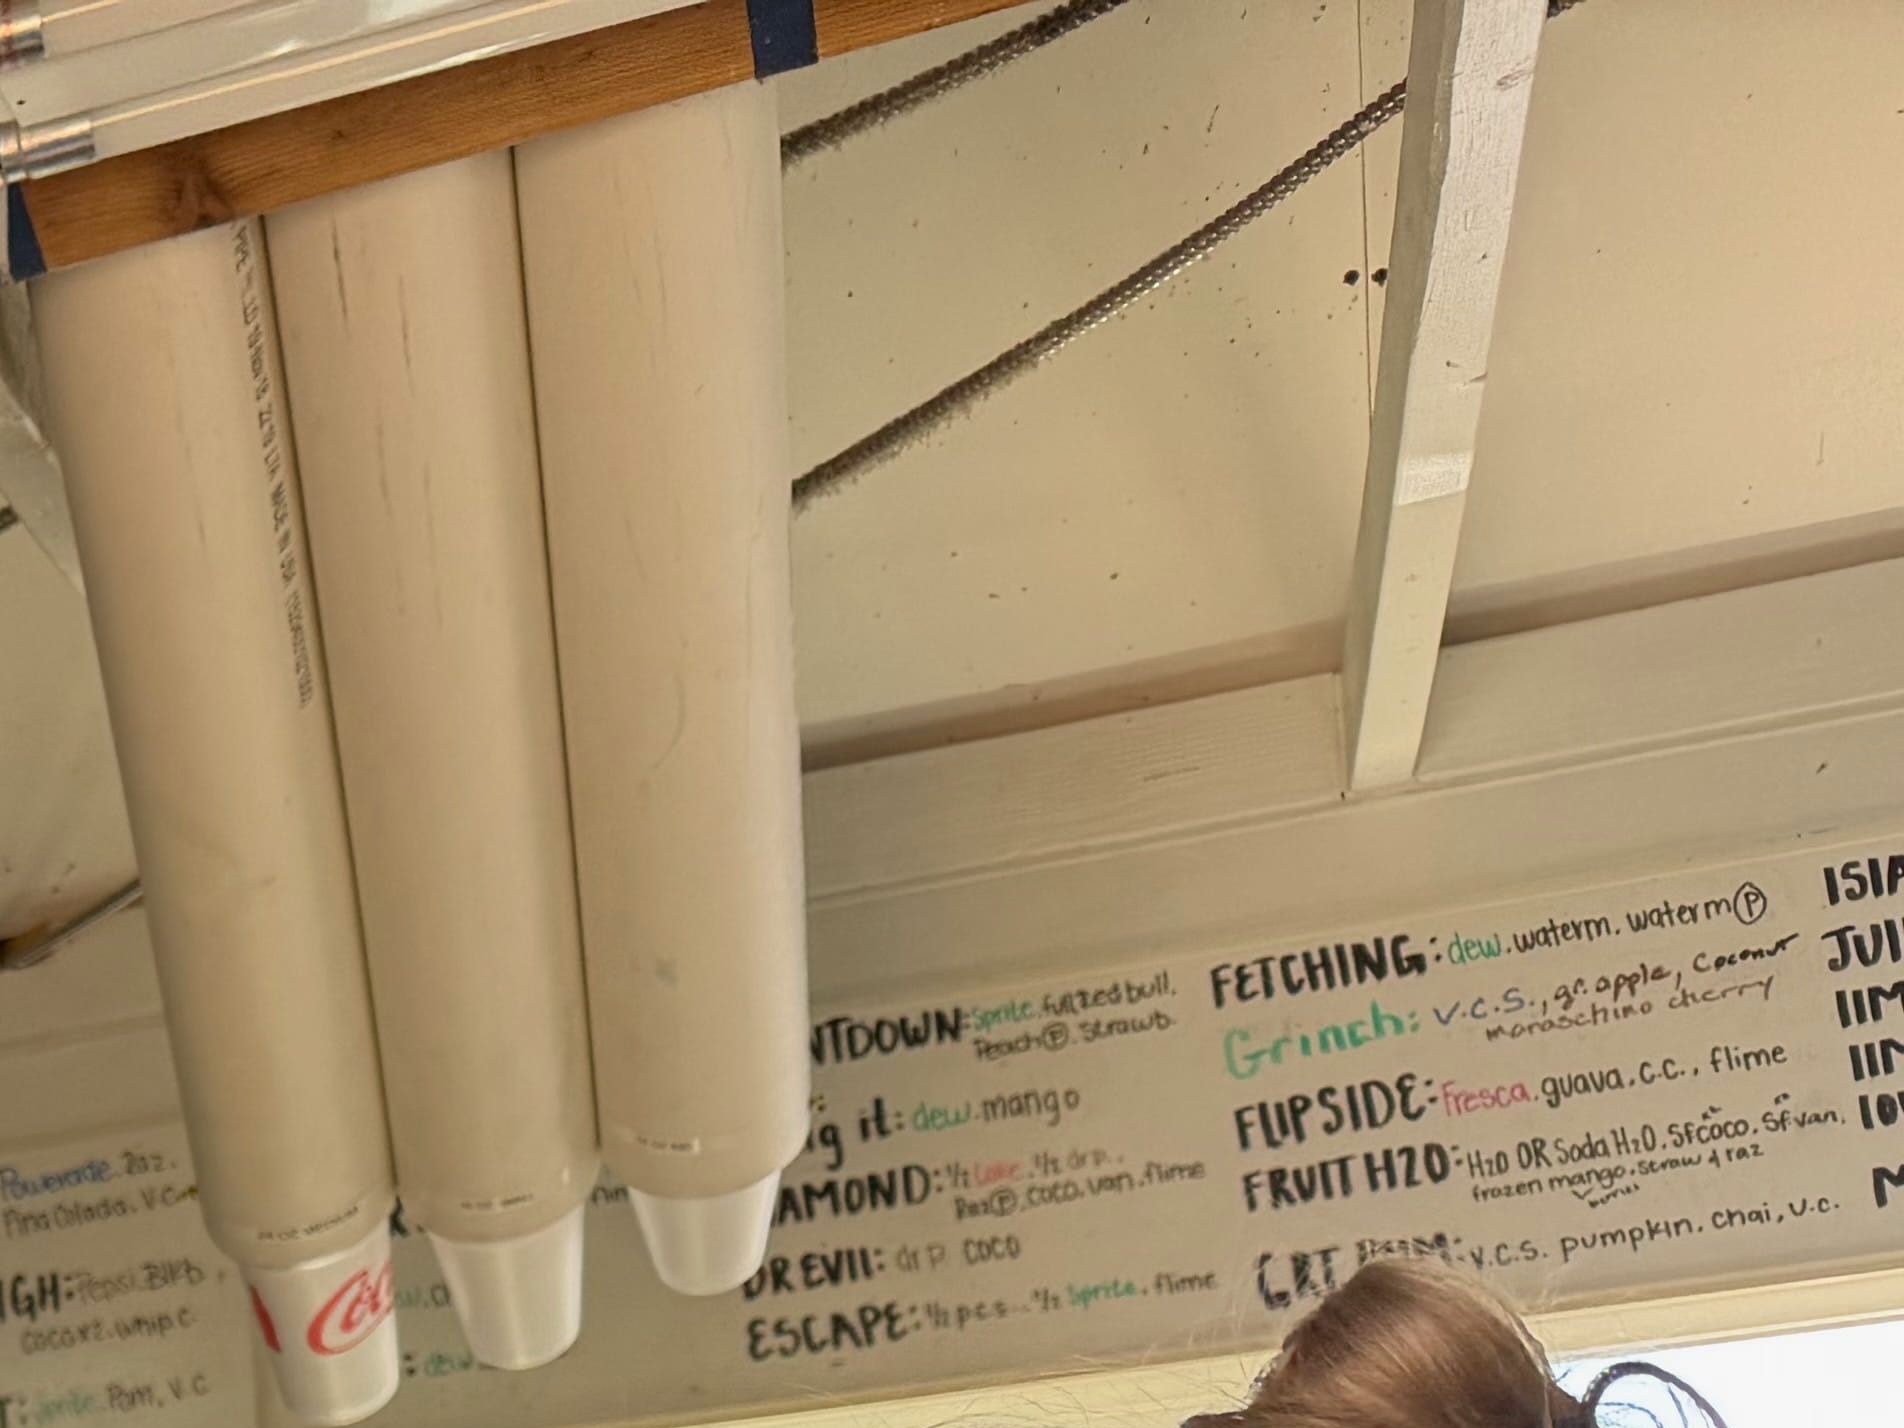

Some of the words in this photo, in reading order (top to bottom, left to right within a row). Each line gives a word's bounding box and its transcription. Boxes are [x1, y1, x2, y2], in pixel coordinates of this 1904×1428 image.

[1210, 934, 1443, 1009] FETCHING:
[1667, 974, 1775, 1010] cherry
[1223, 999, 1422, 1080] Grinch:
[982, 1087, 1080, 1127] mango
[1234, 1072, 1439, 1152] FLIPSIDE:
[1709, 1044, 1788, 1075] flime
[770, 1163, 944, 1229] AMOND:
[1242, 1154, 1356, 1213] FRUIT
[1517, 1141, 1553, 1171] OR
[1555, 1133, 1610, 1166] Soda
[1473, 1178, 1543, 1203] frozen
[1726, 1143, 1765, 1162] raz
[746, 1298, 923, 1363] ESCAPE:
